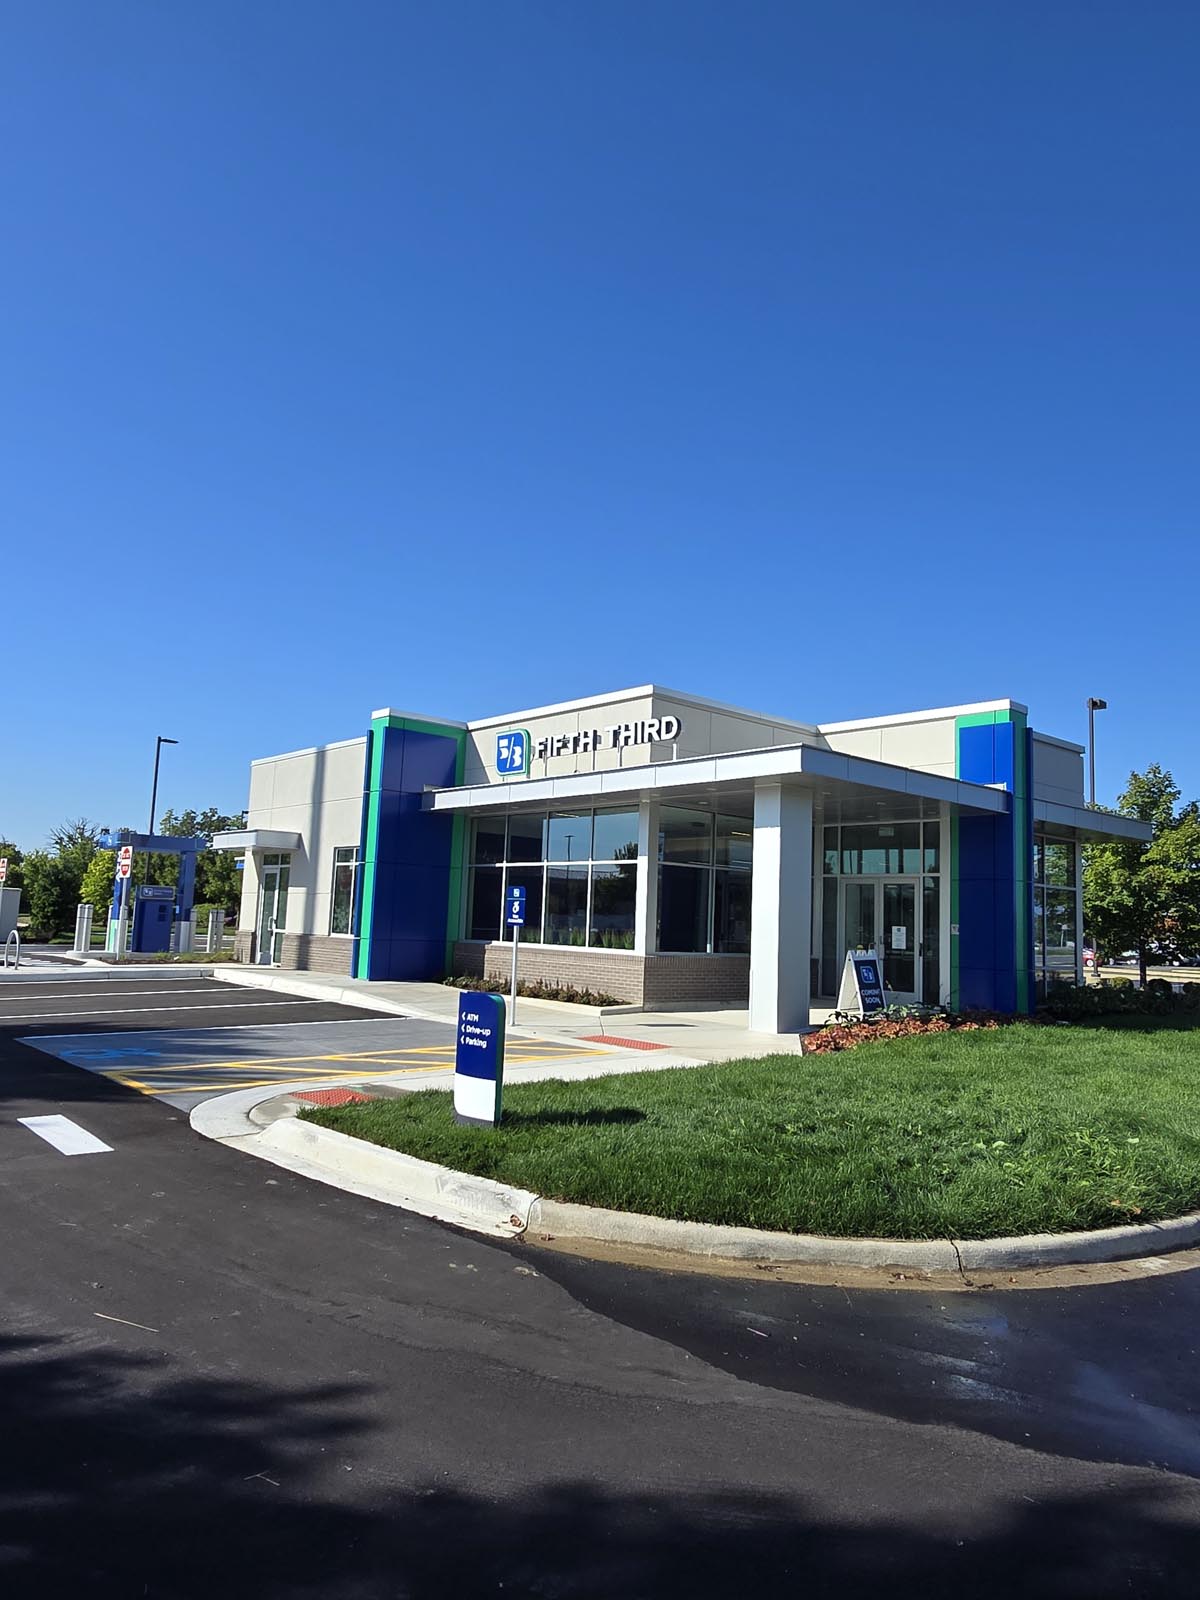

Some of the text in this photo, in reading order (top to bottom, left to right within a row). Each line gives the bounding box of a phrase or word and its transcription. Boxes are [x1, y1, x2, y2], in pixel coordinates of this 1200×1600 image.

[534, 730, 597, 760] FIFTH
[603, 715, 680, 748] THIRD
[467, 1013, 479, 1022] ATM
[466, 1024, 491, 1037] Drive-up
[465, 1036, 487, 1048] Parking
